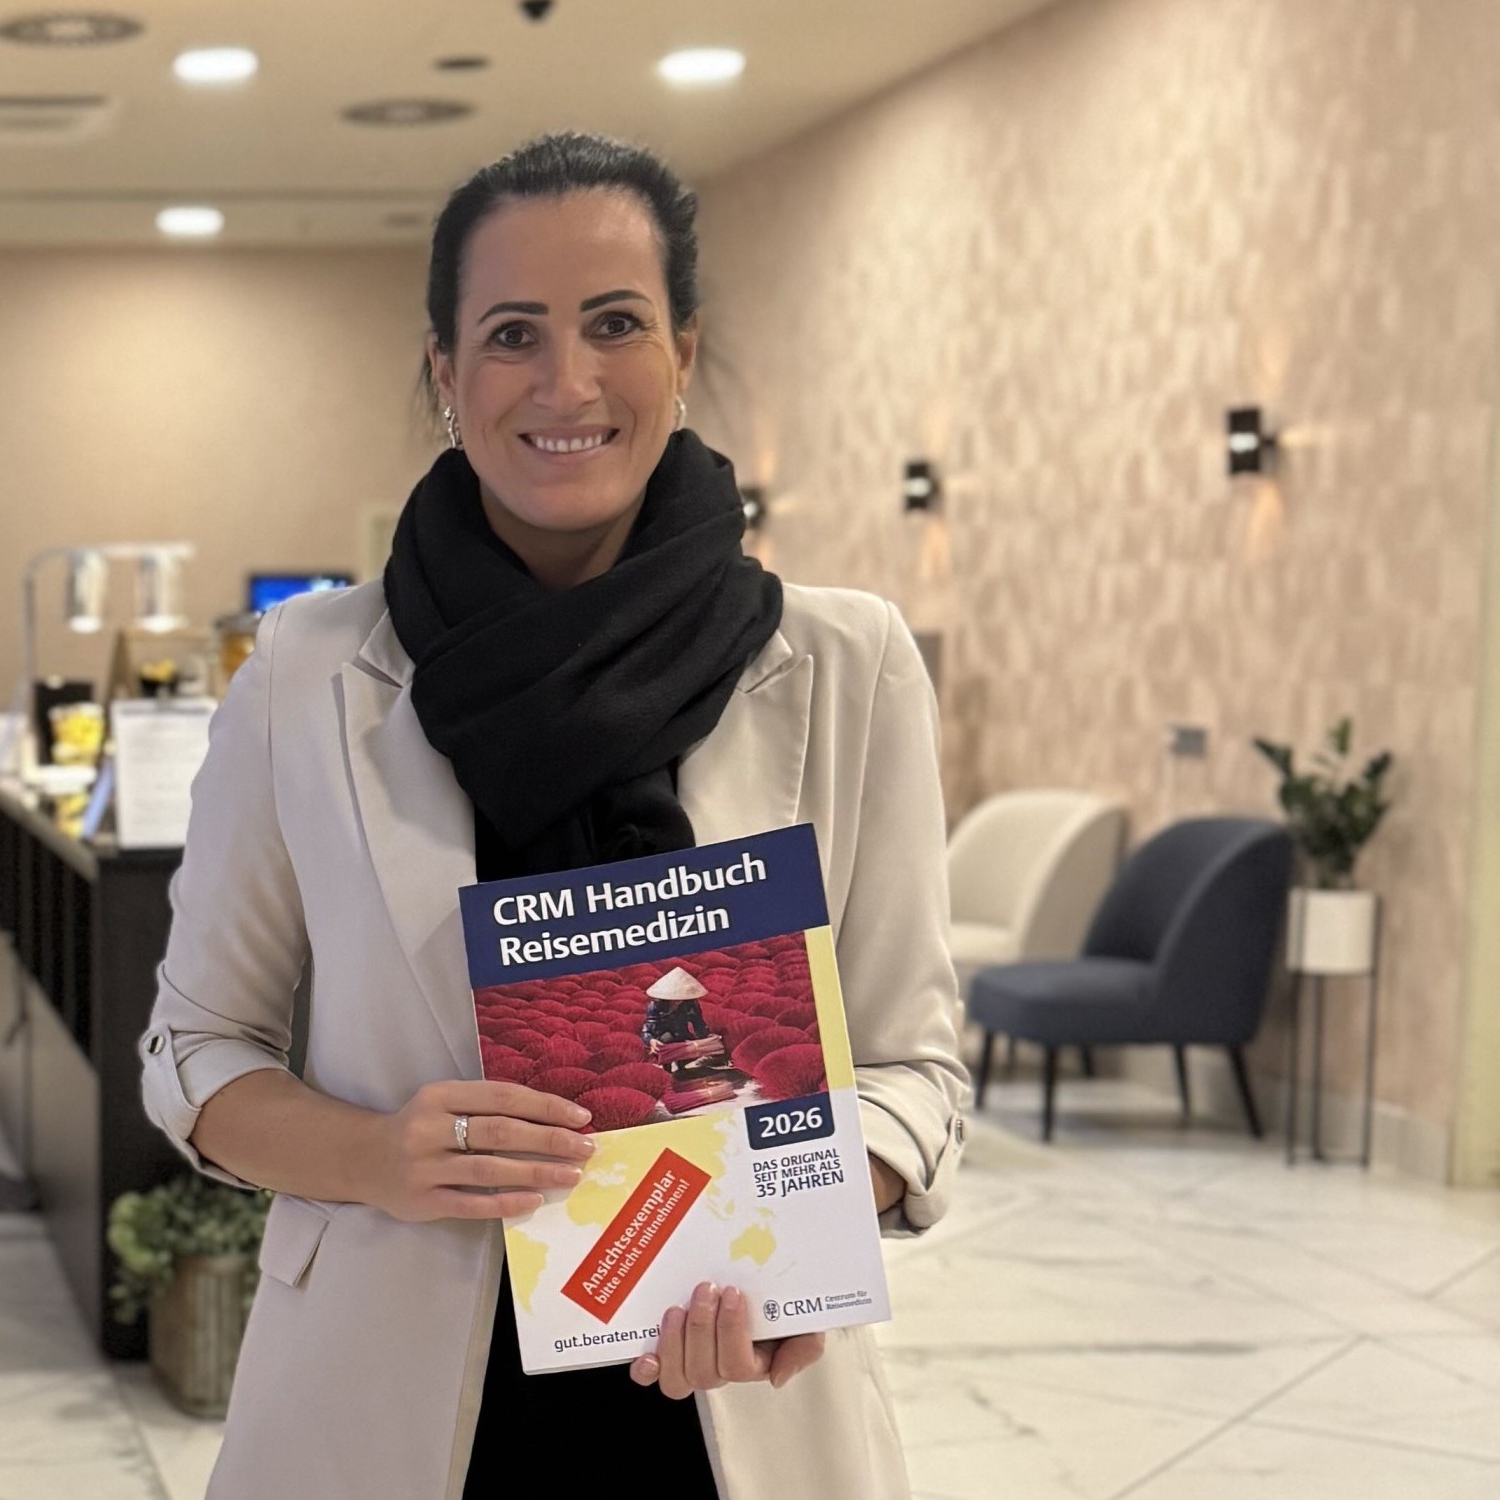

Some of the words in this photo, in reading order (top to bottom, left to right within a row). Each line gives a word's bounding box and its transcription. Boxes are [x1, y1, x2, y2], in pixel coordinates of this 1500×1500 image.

[493, 888, 575, 925] CRM
[586, 852, 767, 913] Handbuch
[499, 905, 730, 966] Reisemedizin
[759, 1107, 823, 1138] 2026
[753, 1159, 778, 1173] DAS
[780, 1148, 840, 1168] ORIGINAL
[754, 1171, 778, 1184] SEIT
[781, 1164, 816, 1179] MEHR
[819, 1159, 841, 1172] ALS
[756, 1182, 777, 1198] 35
[780, 1169, 844, 1198] JAHREN
[582, 1170, 676, 1295] Ansichtsexemplar
[594, 1276, 621, 1305] bitte
[617, 1247, 643, 1277] nicht
[638, 1179, 690, 1249] mitnehmen!
[783, 1297, 823, 1316] CRM
[554, 1325, 661, 1352] gut.beraten.rei
